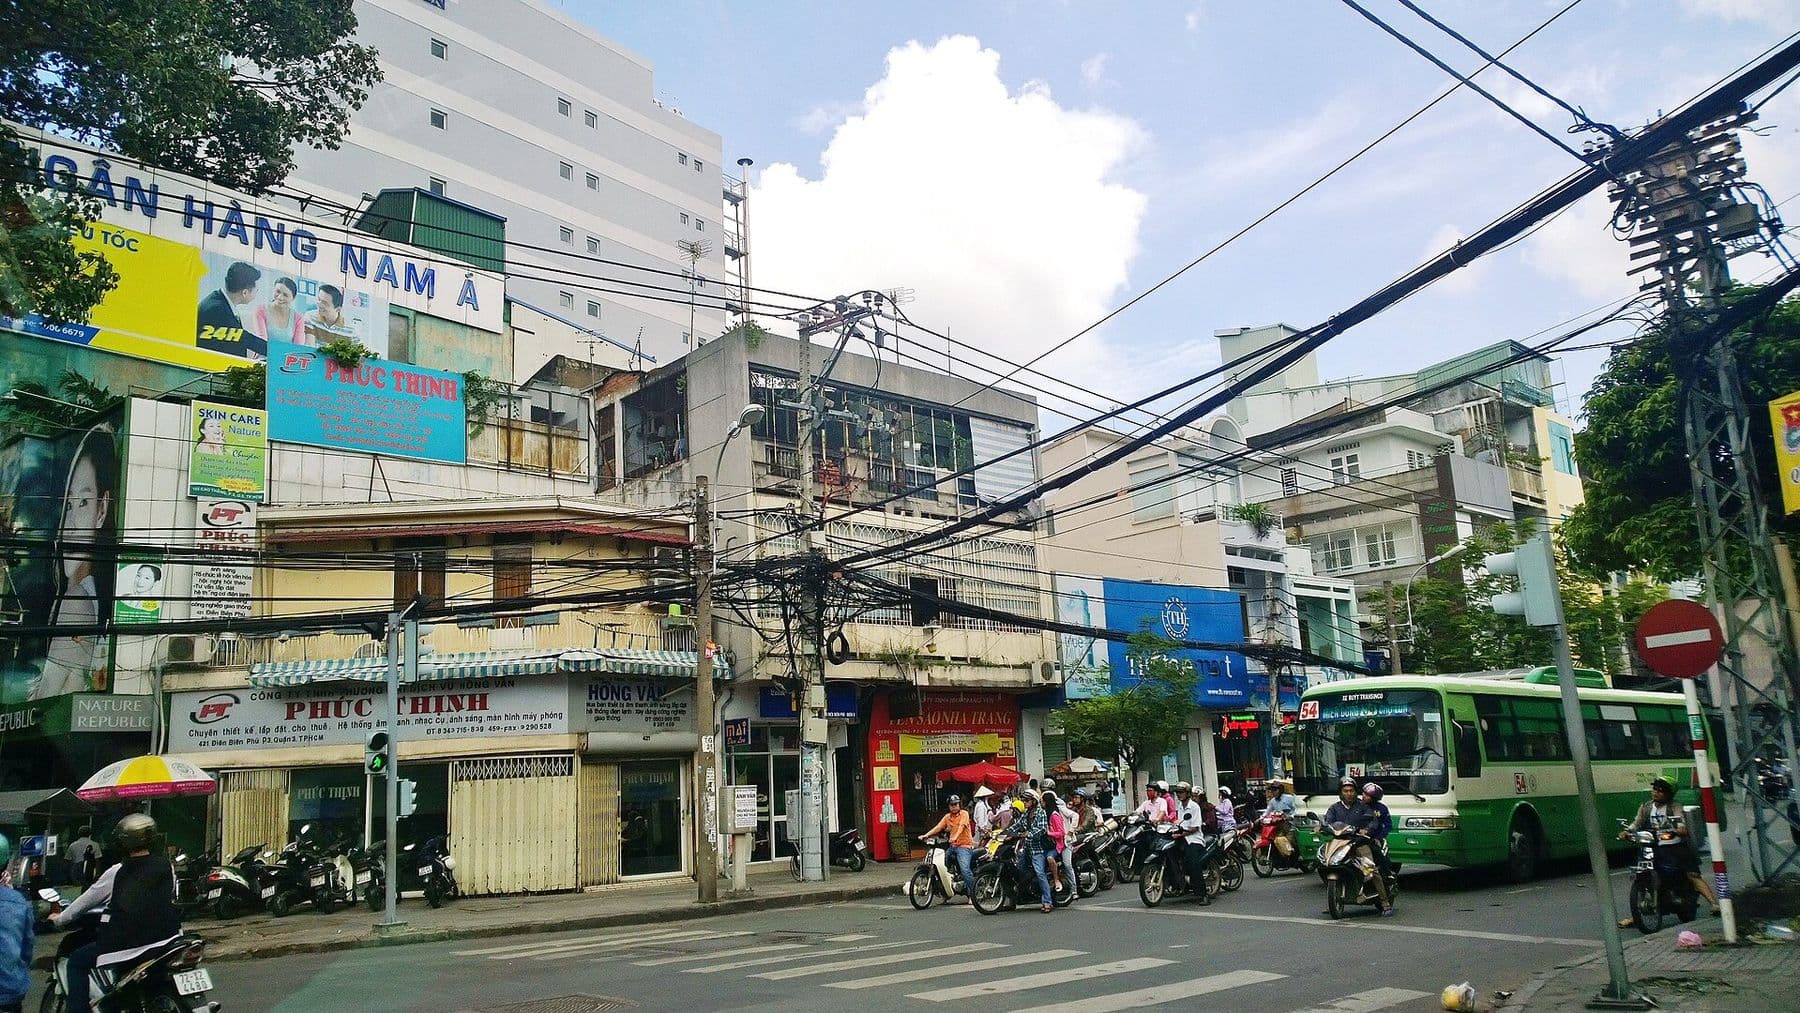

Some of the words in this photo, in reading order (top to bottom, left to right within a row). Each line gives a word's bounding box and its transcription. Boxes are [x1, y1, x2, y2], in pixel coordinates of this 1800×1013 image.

[32, 150, 158, 219] GÂN
[183, 193, 318, 263] HÀNG
[340, 242, 435, 300] NAM
[101, 229, 140, 252] TỐC
[62, 326, 84, 338] 6679
[200, 324, 244, 343] 24H
[285, 354, 311, 370] PT
[325, 357, 386, 388] PHÚC
[391, 370, 458, 402] THỊNH
[198, 407, 227, 420] SKIN
[230, 413, 261, 426] CARE
[228, 425, 261, 438] Nature
[1166, 609, 1186, 625] TH
[250, 689, 282, 702] CÔNG
[587, 680, 632, 702] HỒNG
[78, 699, 143, 712] NATURE
[284, 696, 373, 721] PHÚC
[1301, 702, 1318, 719] 54
[0, 707, 37, 732] EPUBLIC
[77, 715, 152, 728] REPUBLIC
[971, 710, 1012, 726] TRANG
[188, 728, 218, 738] Chuyên
[291, 724, 307, 732] cho
[1349, 767, 1361, 777] 54
[1515, 774, 1527, 793] 54
[297, 784, 326, 800] PHÚC
[328, 785, 361, 800] THỊNH
